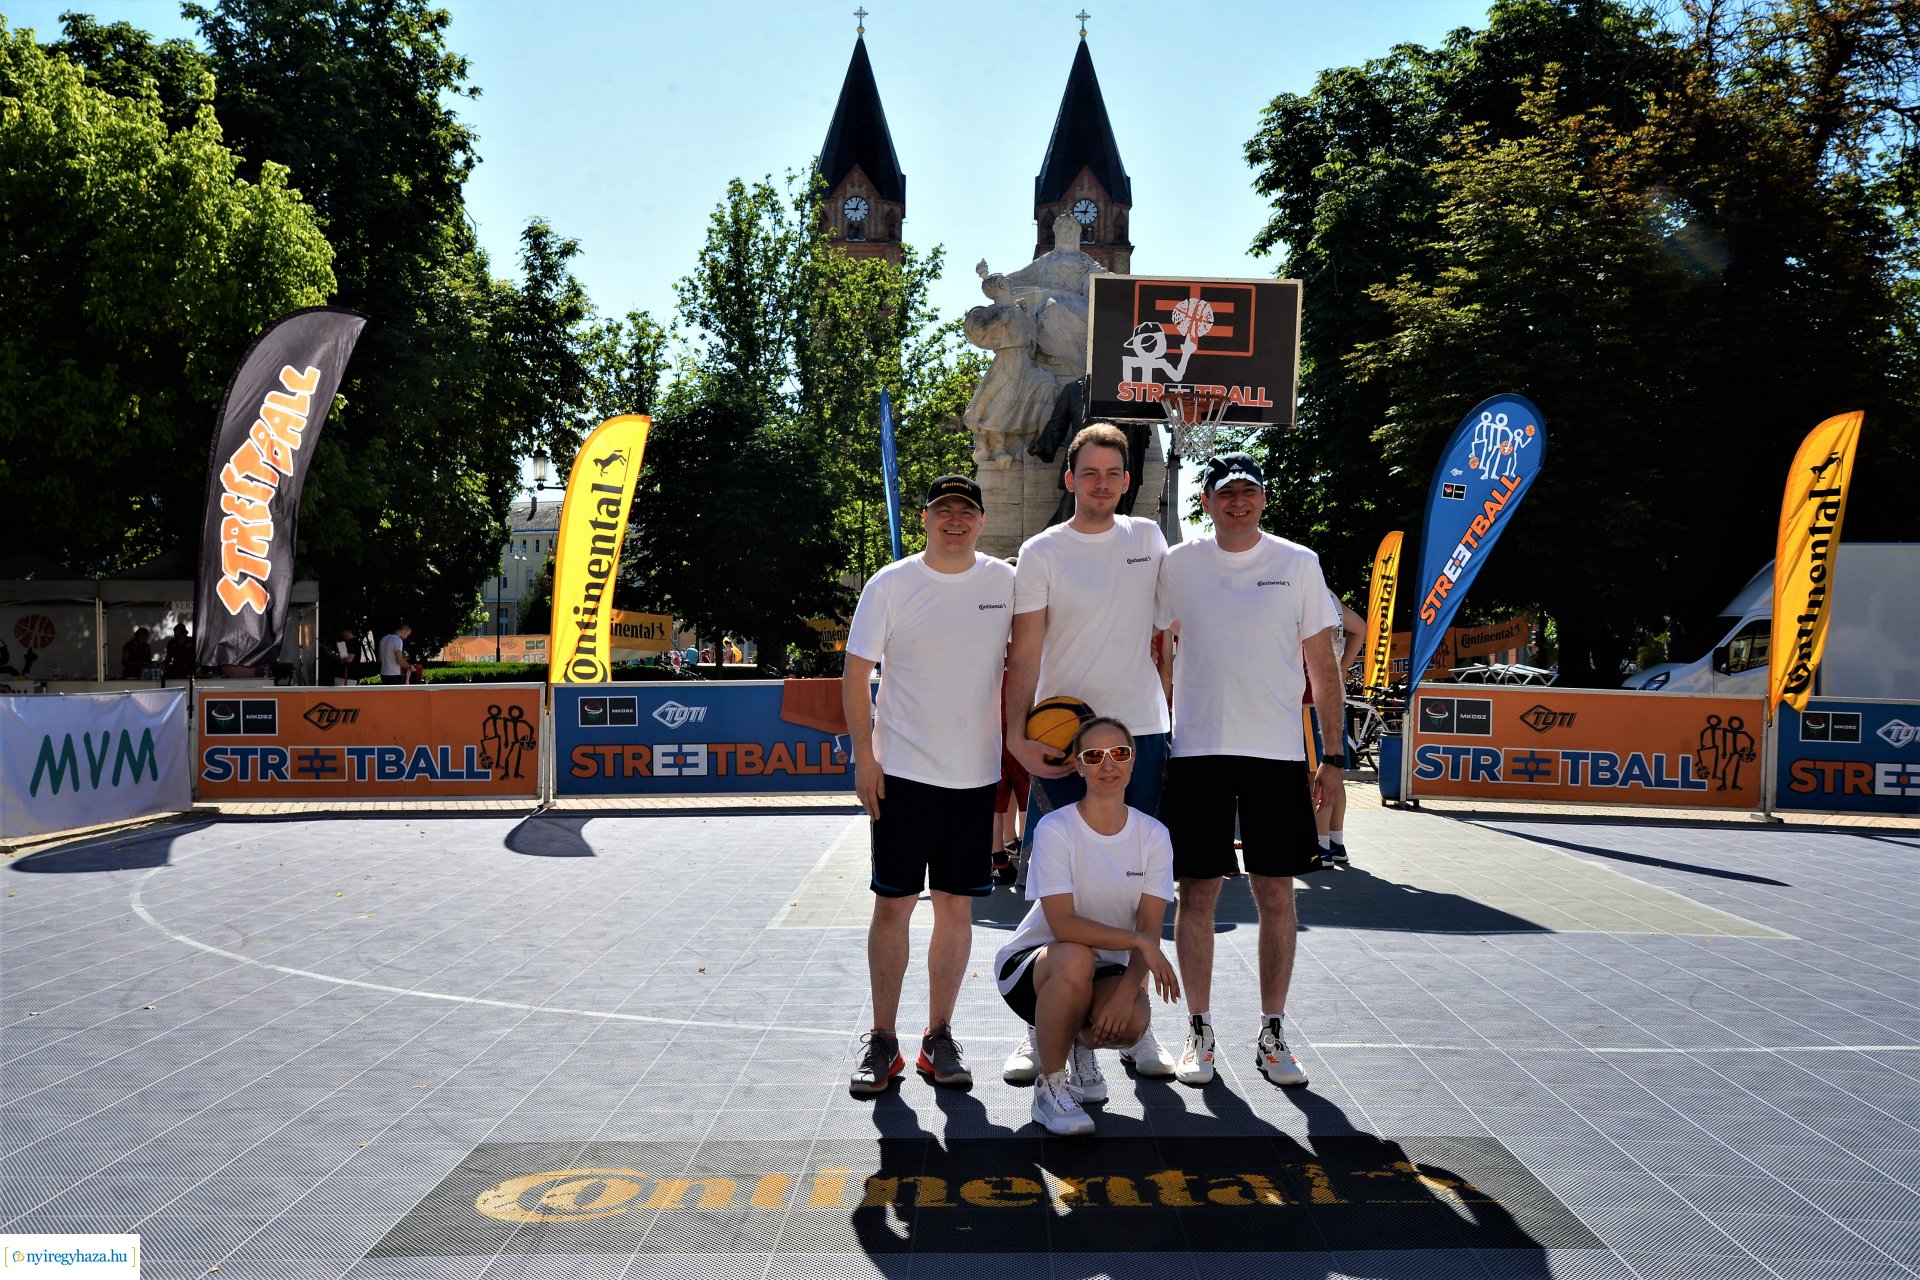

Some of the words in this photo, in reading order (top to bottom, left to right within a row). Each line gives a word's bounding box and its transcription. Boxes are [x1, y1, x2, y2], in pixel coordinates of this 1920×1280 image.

[1117, 381, 1273, 408] STREETBALL
[216, 365, 321, 615] STREETBALL
[1419, 474, 1522, 626] STREETBALL
[1460, 627, 1515, 649] Continental
[318, 708, 360, 725] TOTI
[664, 706, 708, 723] TOTI
[1533, 711, 1578, 728] TOTI
[30, 727, 159, 798] MVM
[202, 745, 492, 782] STREETBALL
[569, 741, 848, 780] STREETBALL
[1413, 743, 1709, 793] STREETBALL
[475, 1164, 1349, 1223] Continental
